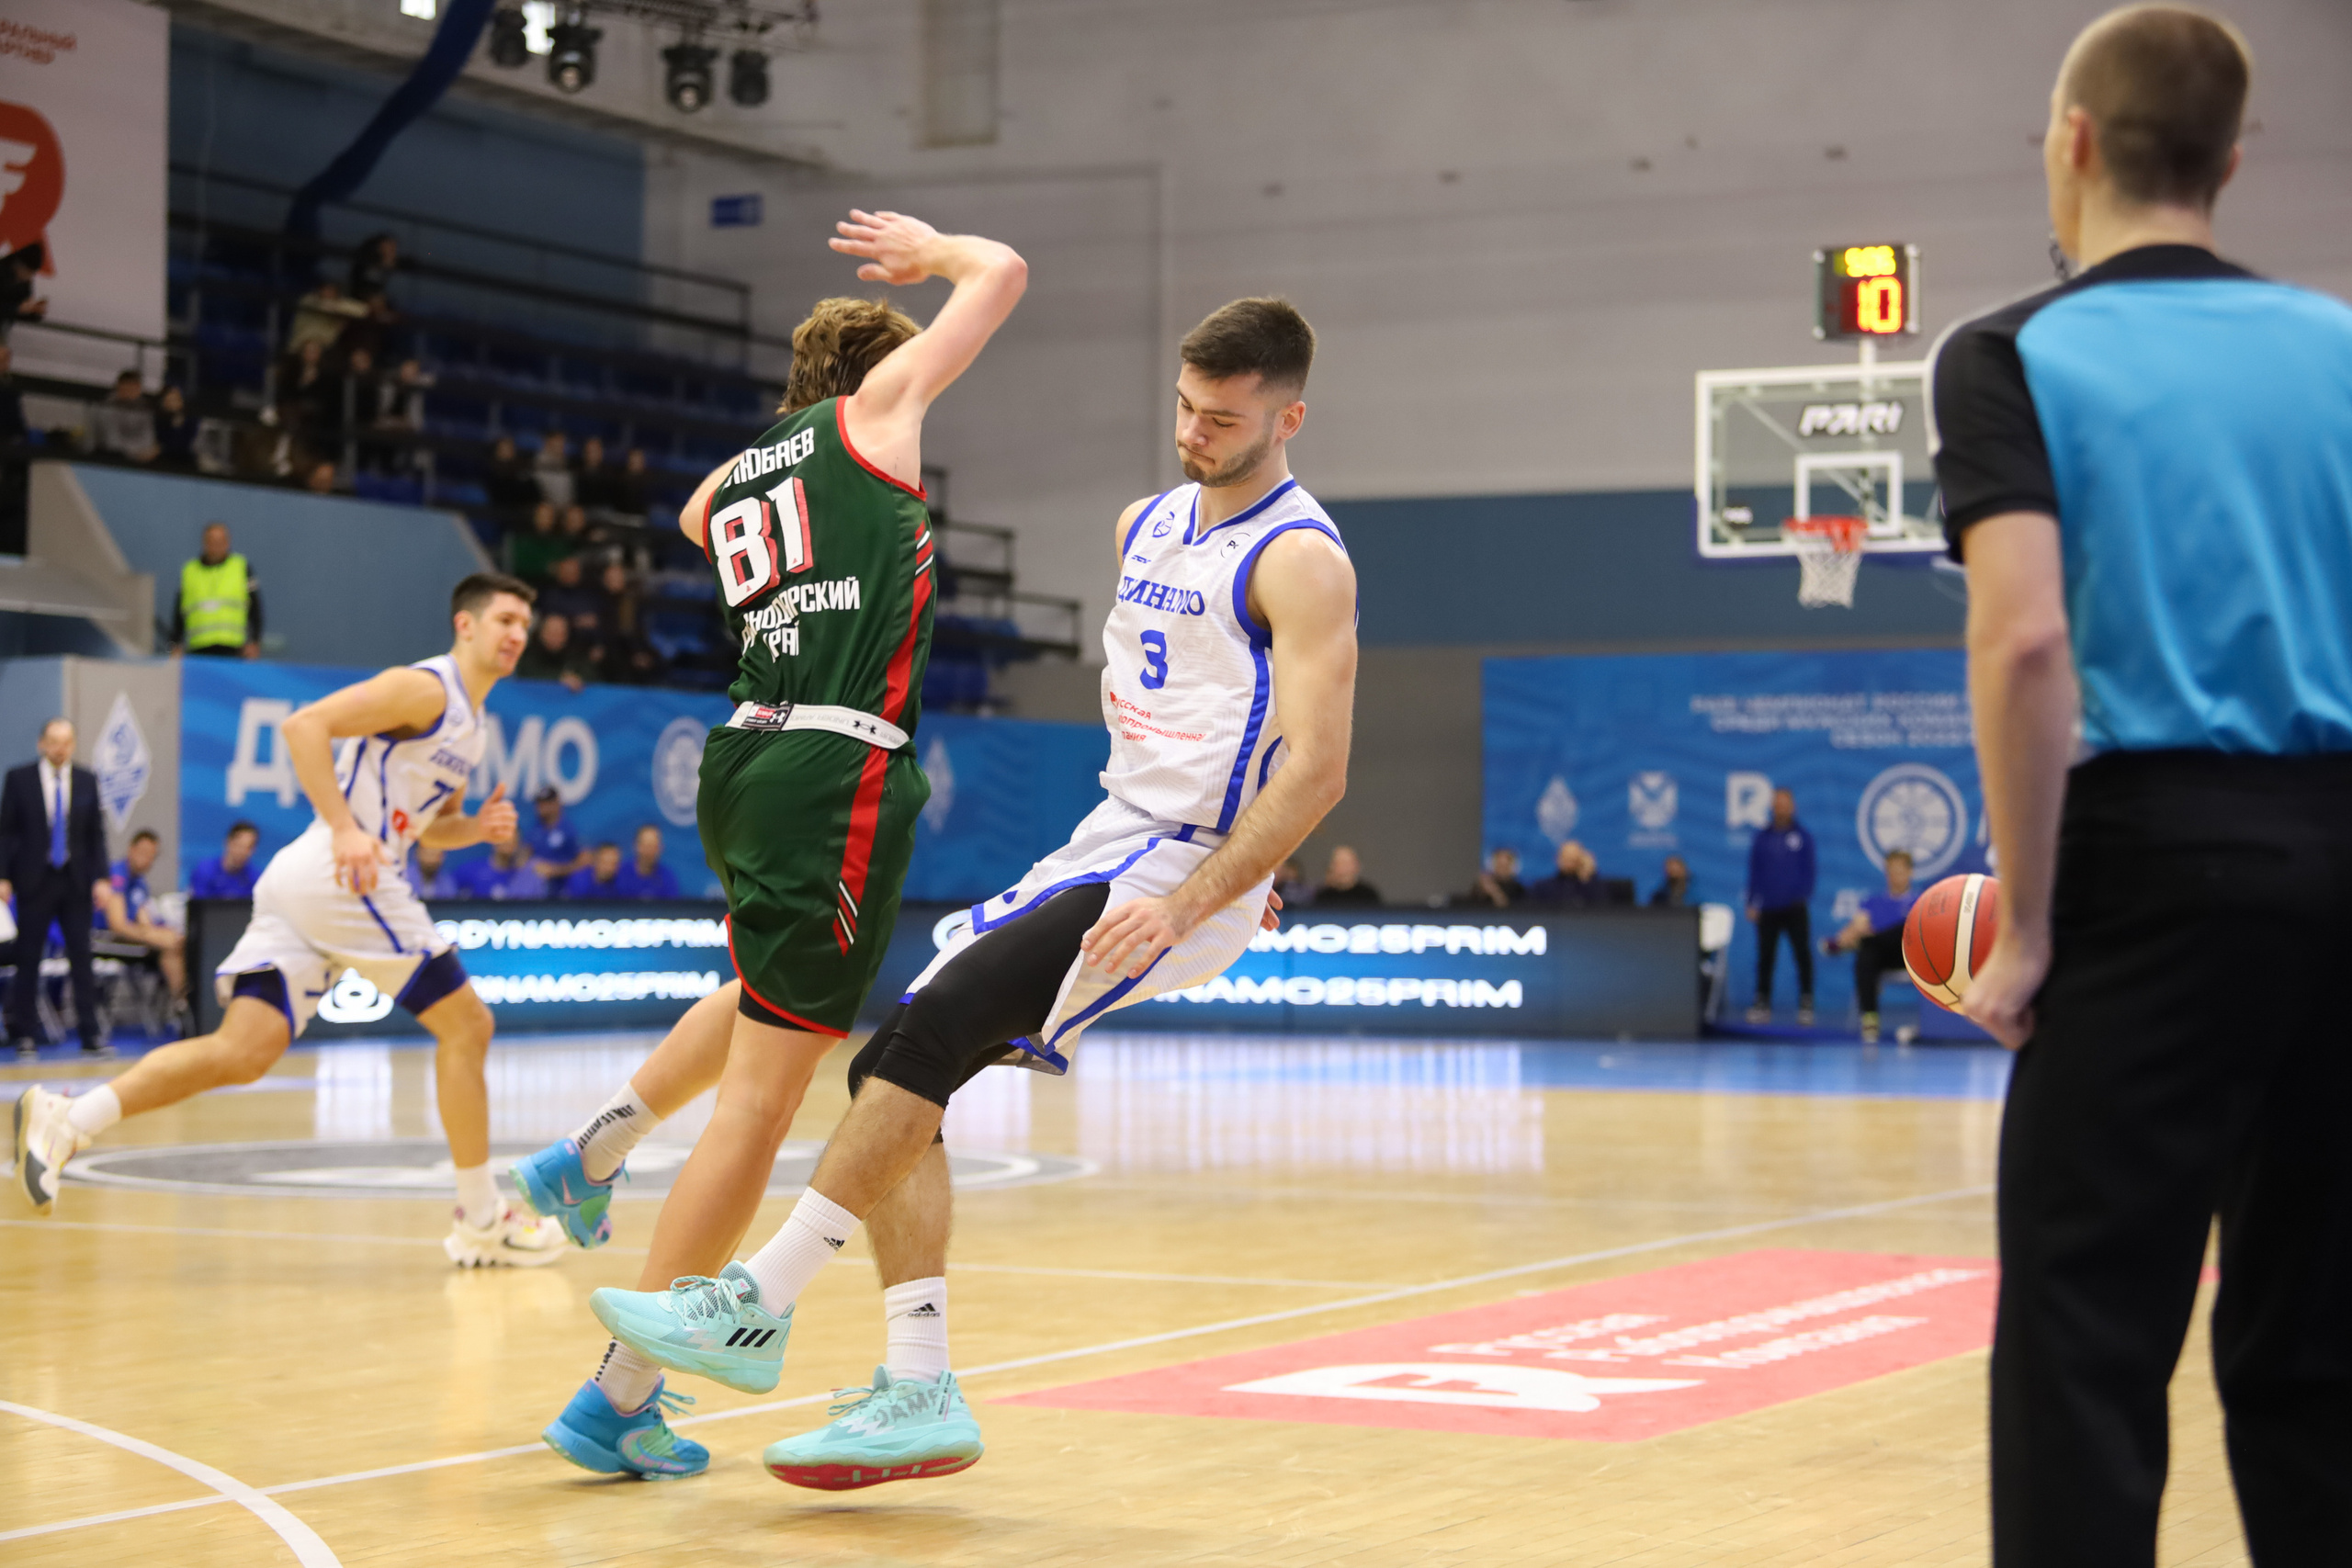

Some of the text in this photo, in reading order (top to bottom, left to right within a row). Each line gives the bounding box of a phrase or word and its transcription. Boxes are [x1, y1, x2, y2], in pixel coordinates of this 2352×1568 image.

[1858, 276, 1902, 333] 10
[1800, 401, 1903, 436] PARI
[710, 476, 812, 607] 81
[1139, 629, 1169, 690] 3
[418, 780, 455, 813] 7
